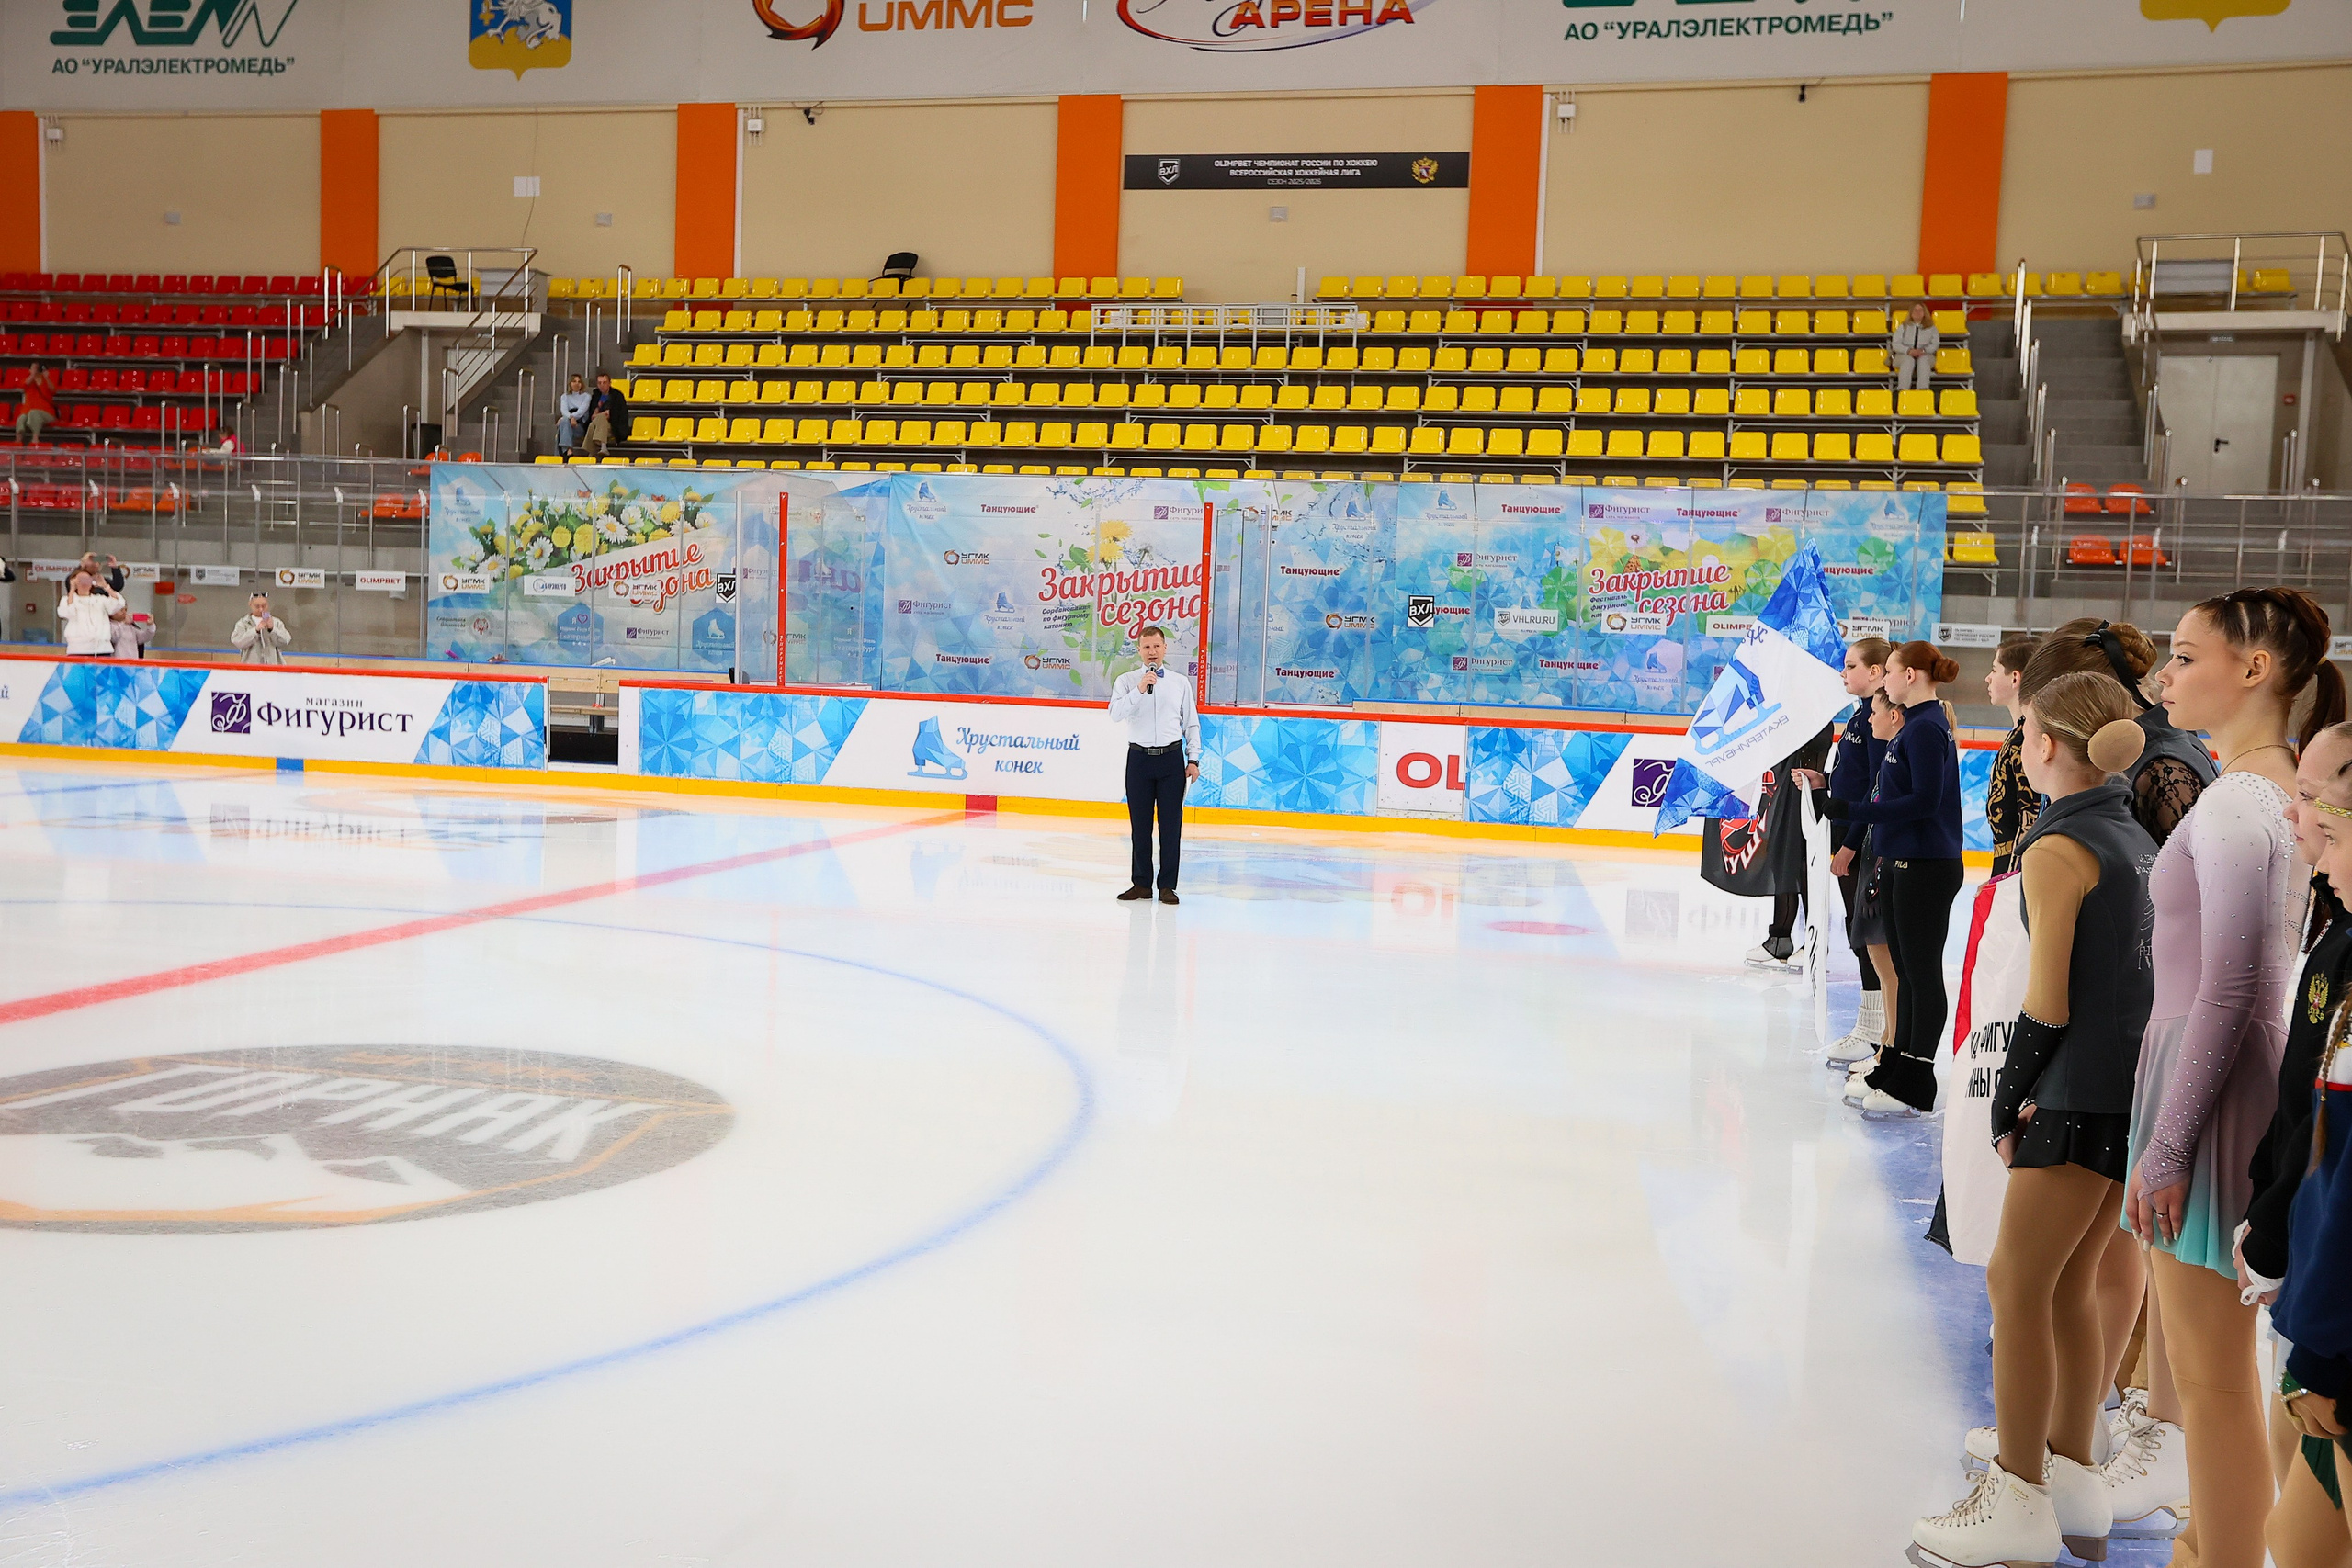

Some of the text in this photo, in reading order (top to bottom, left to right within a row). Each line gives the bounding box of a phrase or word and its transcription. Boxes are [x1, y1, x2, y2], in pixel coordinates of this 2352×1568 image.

[858, 0, 1034, 32] UMMC
[1229, 0, 1414, 29] АРЕНА
[1564, 22, 1599, 41] АО
[52, 58, 78, 74] АО
[1214, 159, 1252, 167] OLIMPBET
[1254, 159, 1300, 167] ЧЕМПИОНАТ
[1301, 159, 1331, 167] РОССИИ
[1345, 159, 1378, 167] ХОККЕЮ
[1159, 164, 1179, 176] ВХЛ
[1229, 167, 1294, 176] ВСЕРОССИЙСКАЯ
[1295, 167, 1340, 176] ХОККЕЙНАЯ
[980, 504, 1036, 514] Танцующие
[1170, 506, 1204, 515] Фигури
[1501, 503, 1561, 514] Танцующие
[1604, 504, 1650, 515] Фигурист
[1676, 507, 1738, 518] Танцующие
[1280, 566, 1340, 577] Танцующие
[1824, 566, 1874, 575] нцующие
[360, 577, 401, 585] OLIMPBET
[1589, 564, 1731, 603] Закрытие
[913, 600, 952, 610] Фигурист
[1409, 603, 1435, 617] ВХЛ
[1590, 602, 1628, 611] фигурного
[1512, 615, 1555, 625] VHLRU.RU
[935, 653, 990, 664] Танцующие
[1275, 667, 1335, 678] Танцующие
[306, 696, 363, 708] магазин
[257, 701, 413, 737] Фигурист
[956, 727, 1080, 754] Хрустальный
[994, 759, 1044, 774] конек
[1894, 860, 1908, 869] FILA
